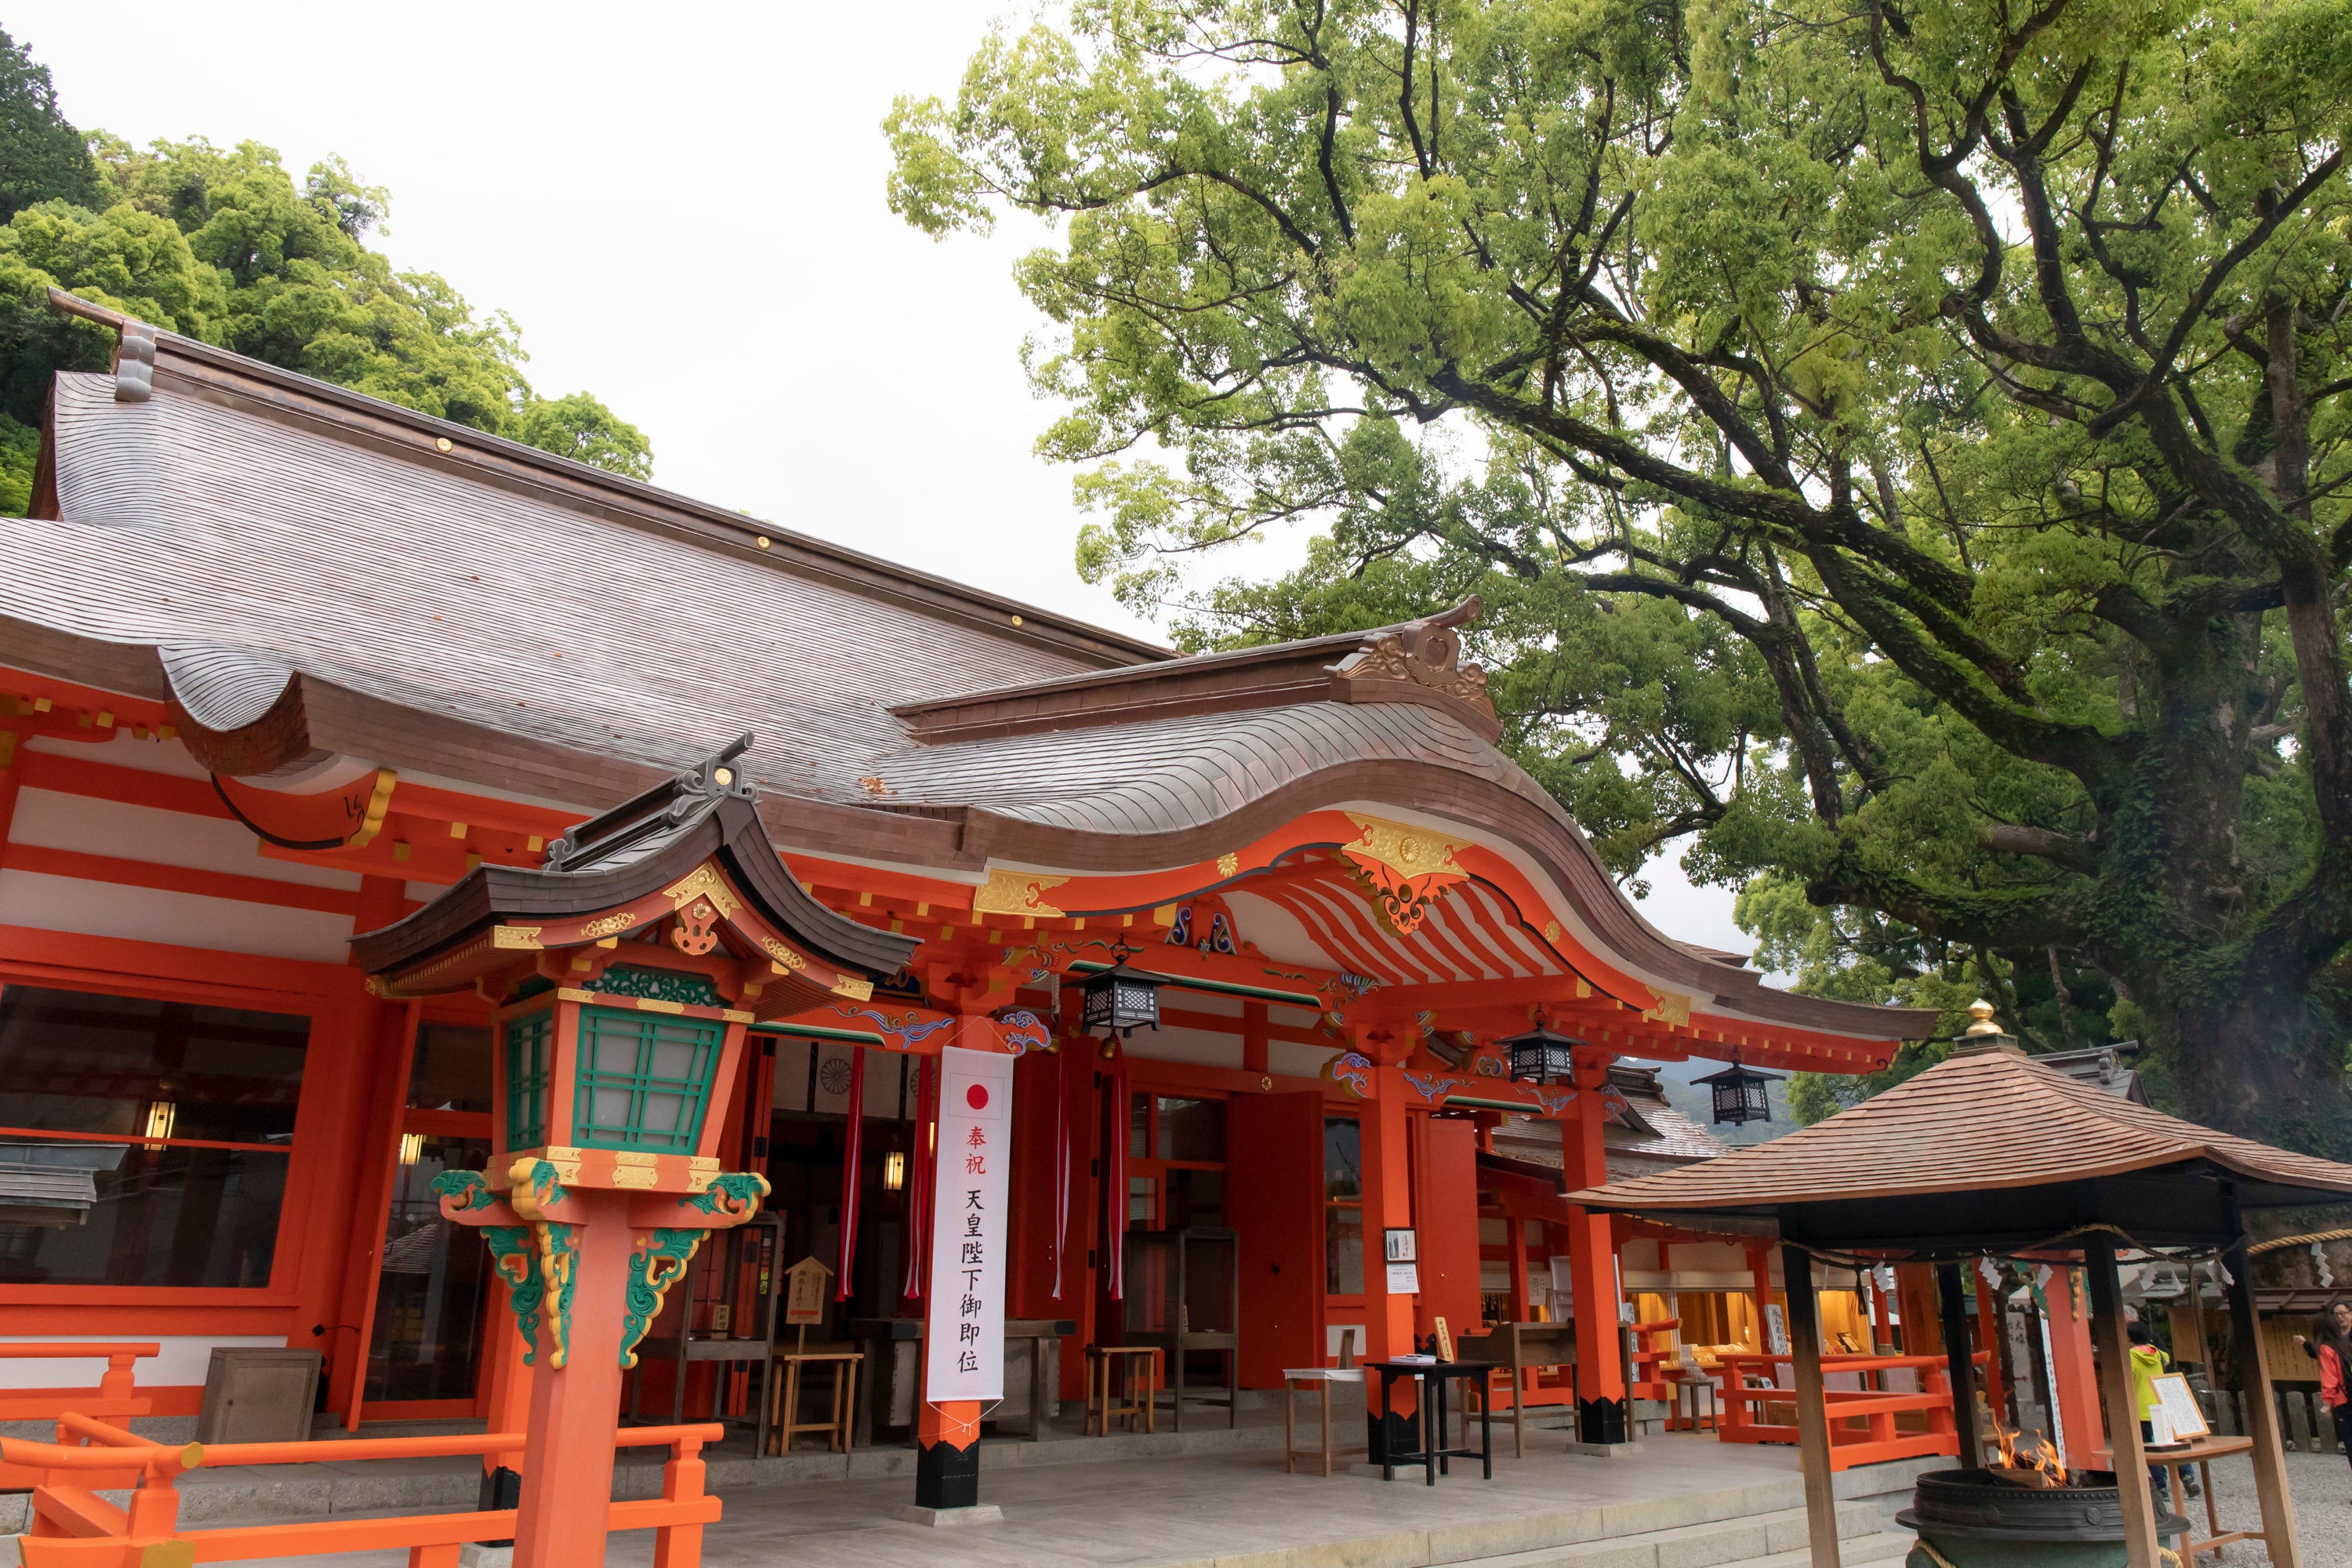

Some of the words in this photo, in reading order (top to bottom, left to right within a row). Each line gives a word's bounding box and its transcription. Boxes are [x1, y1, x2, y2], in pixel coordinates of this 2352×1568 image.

[965, 1126, 987, 1175] 奉祝
[956, 1189, 985, 1374] 天皇陛下御即位
